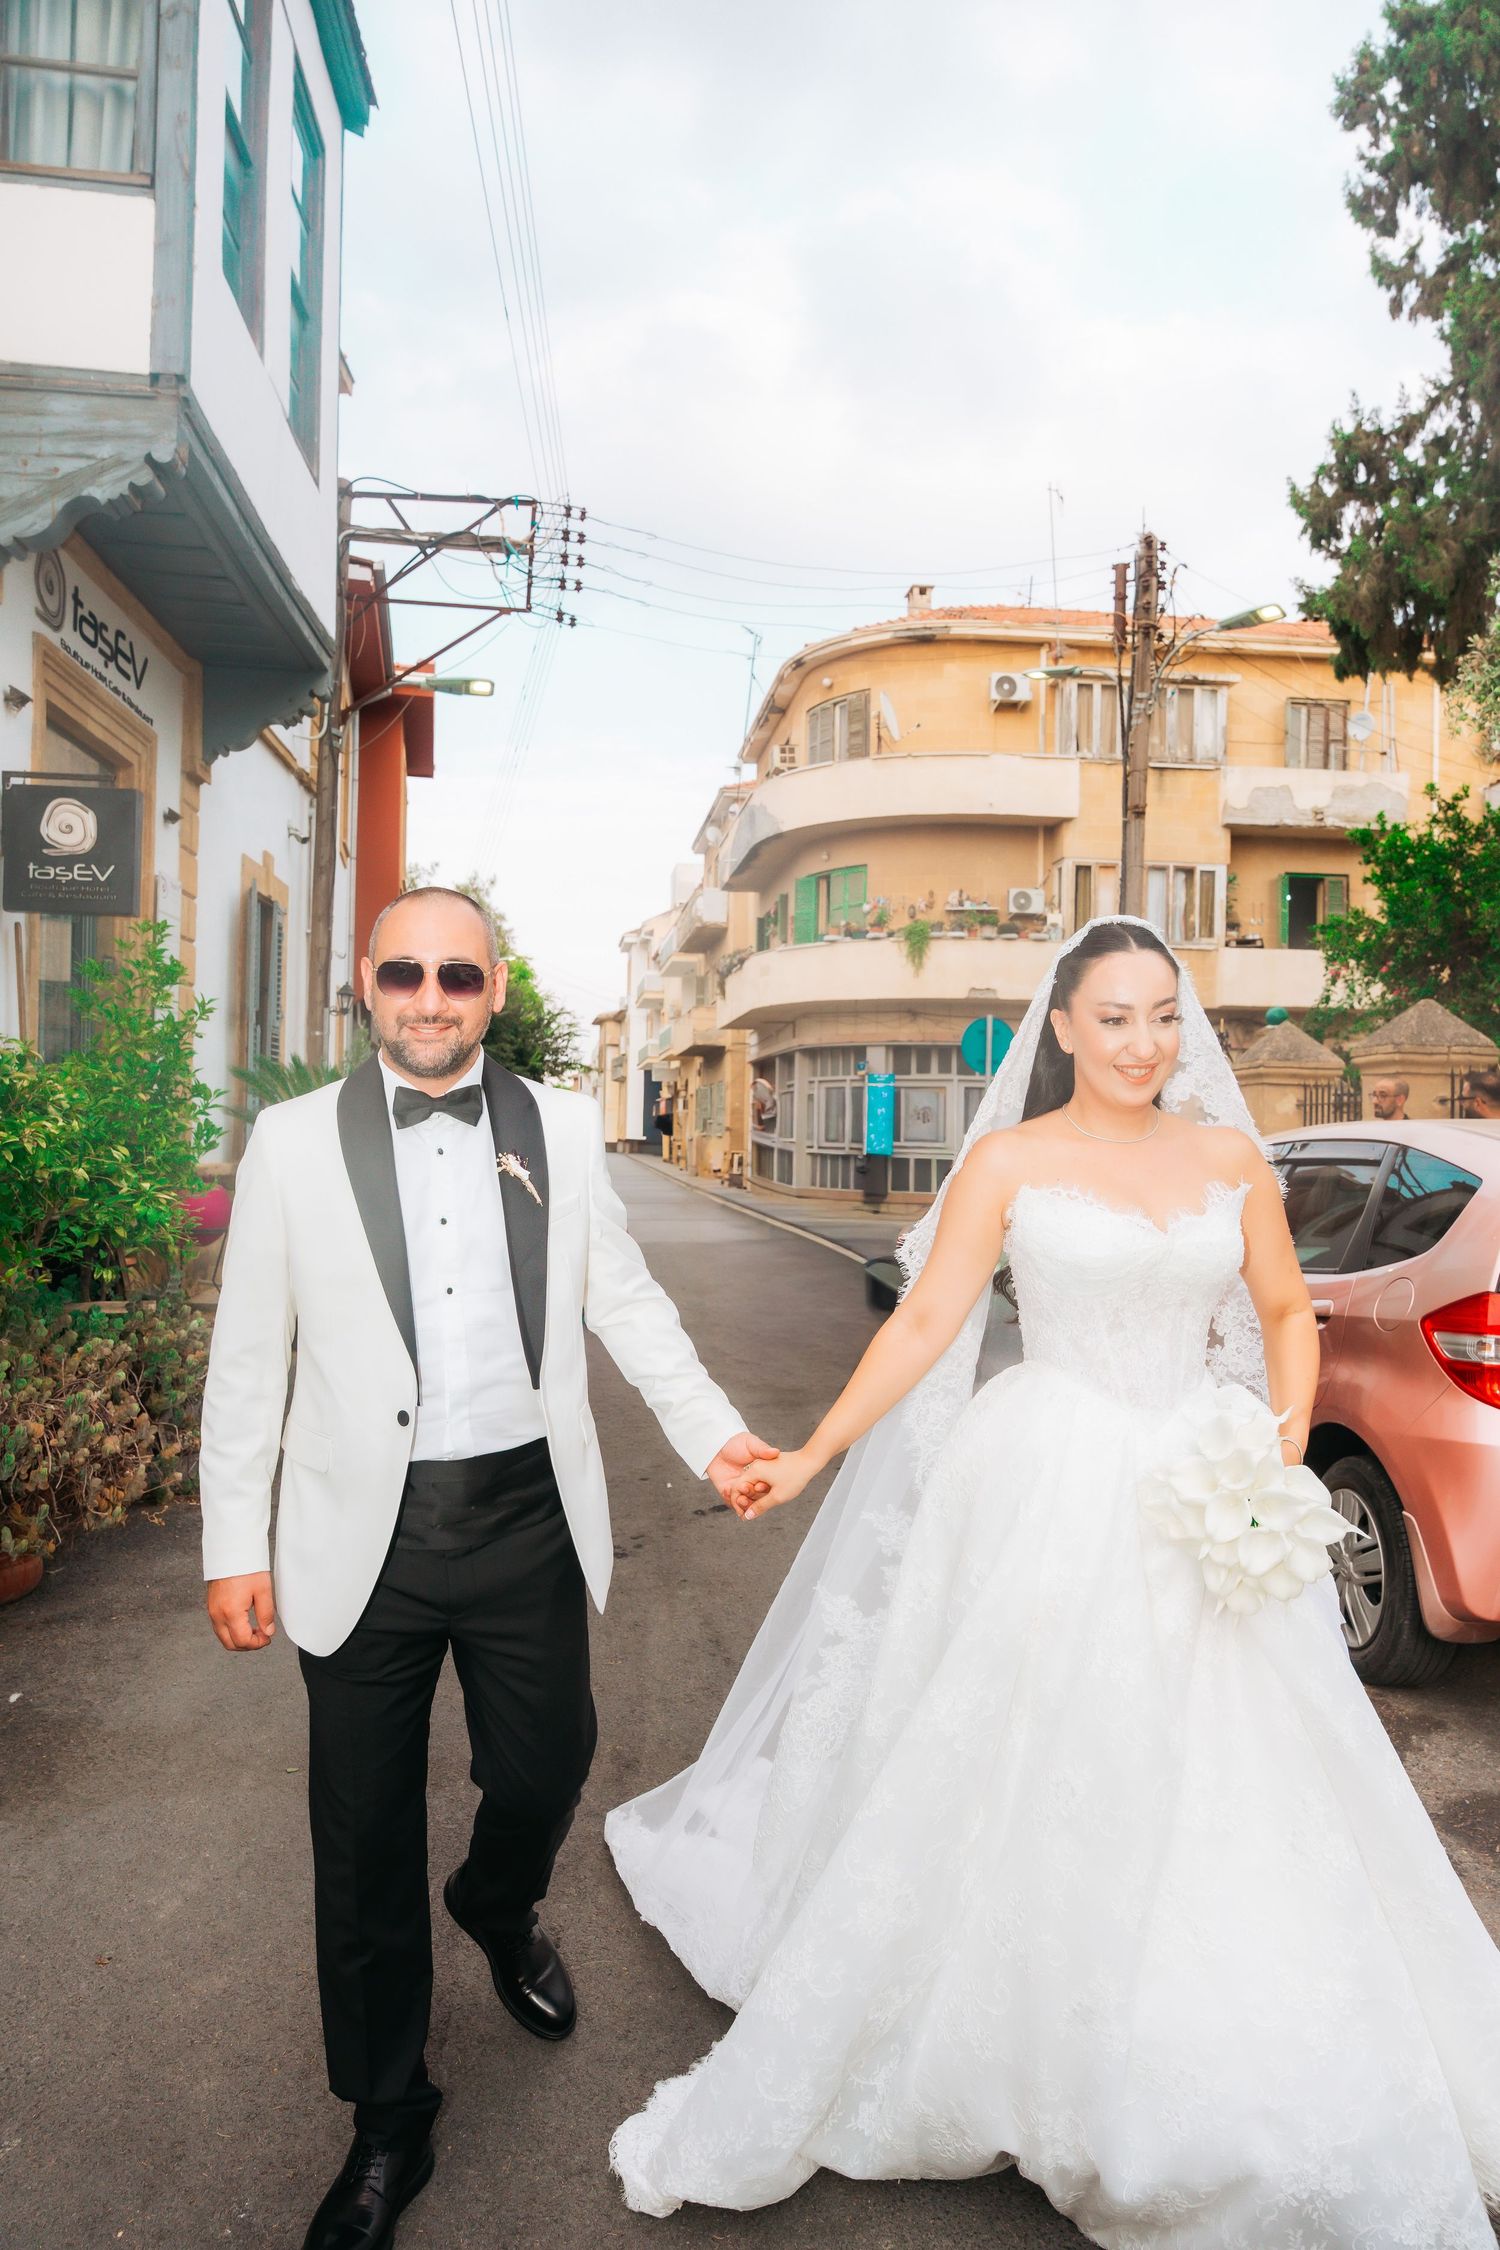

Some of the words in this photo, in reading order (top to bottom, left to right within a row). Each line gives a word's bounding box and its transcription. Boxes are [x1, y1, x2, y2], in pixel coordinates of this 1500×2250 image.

[72, 585, 149, 690] taşEV
[60, 638, 91, 670] Boutique
[28, 862, 115, 883] taşEV
